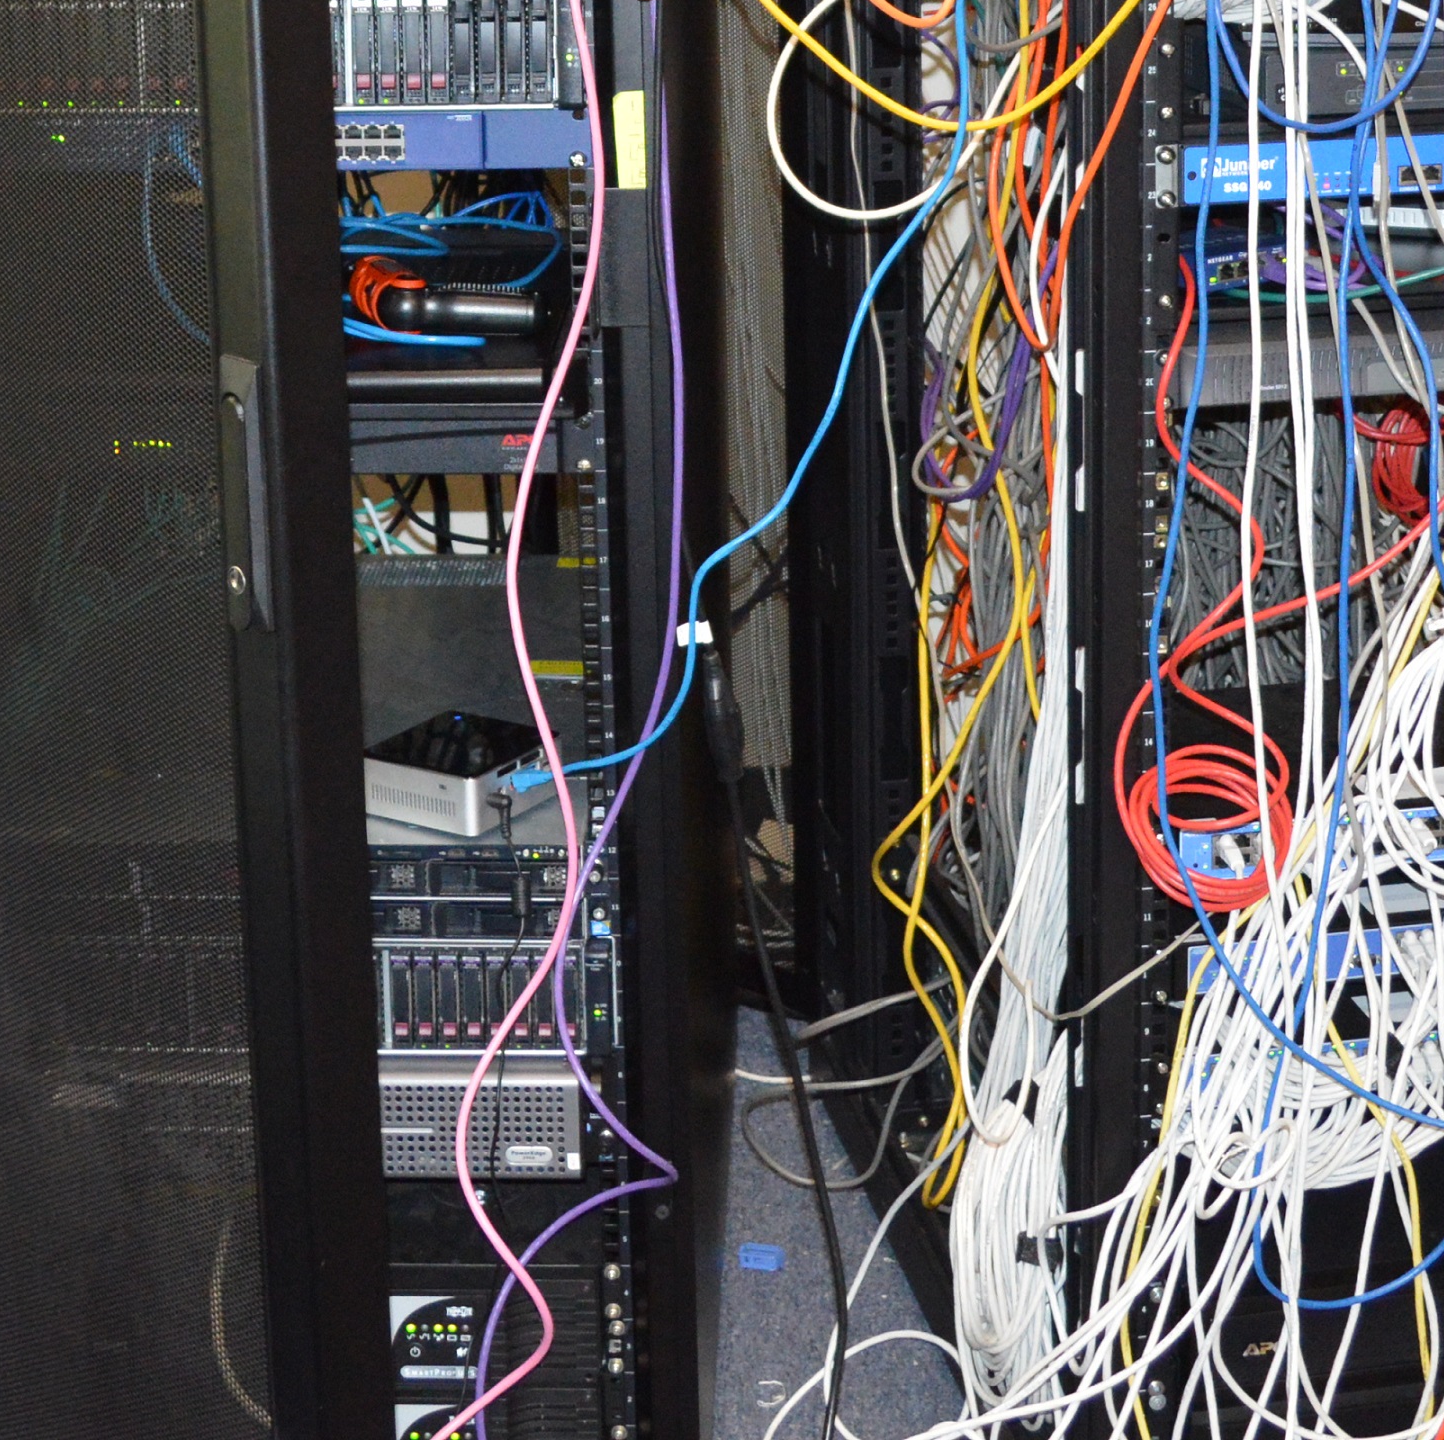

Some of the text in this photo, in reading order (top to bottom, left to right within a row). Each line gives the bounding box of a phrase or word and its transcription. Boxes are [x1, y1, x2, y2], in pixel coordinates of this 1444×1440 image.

[1222, 157, 1276, 172] Juner
[1207, 255, 1234, 264] NETGEAR
[594, 377, 603, 385] 20
[1145, 438, 1154, 447] 19
[1145, 499, 1154, 508] 18
[1145, 559, 1154, 568] 17
[1144, 737, 1153, 746] 14
[606, 789, 615, 797] 13
